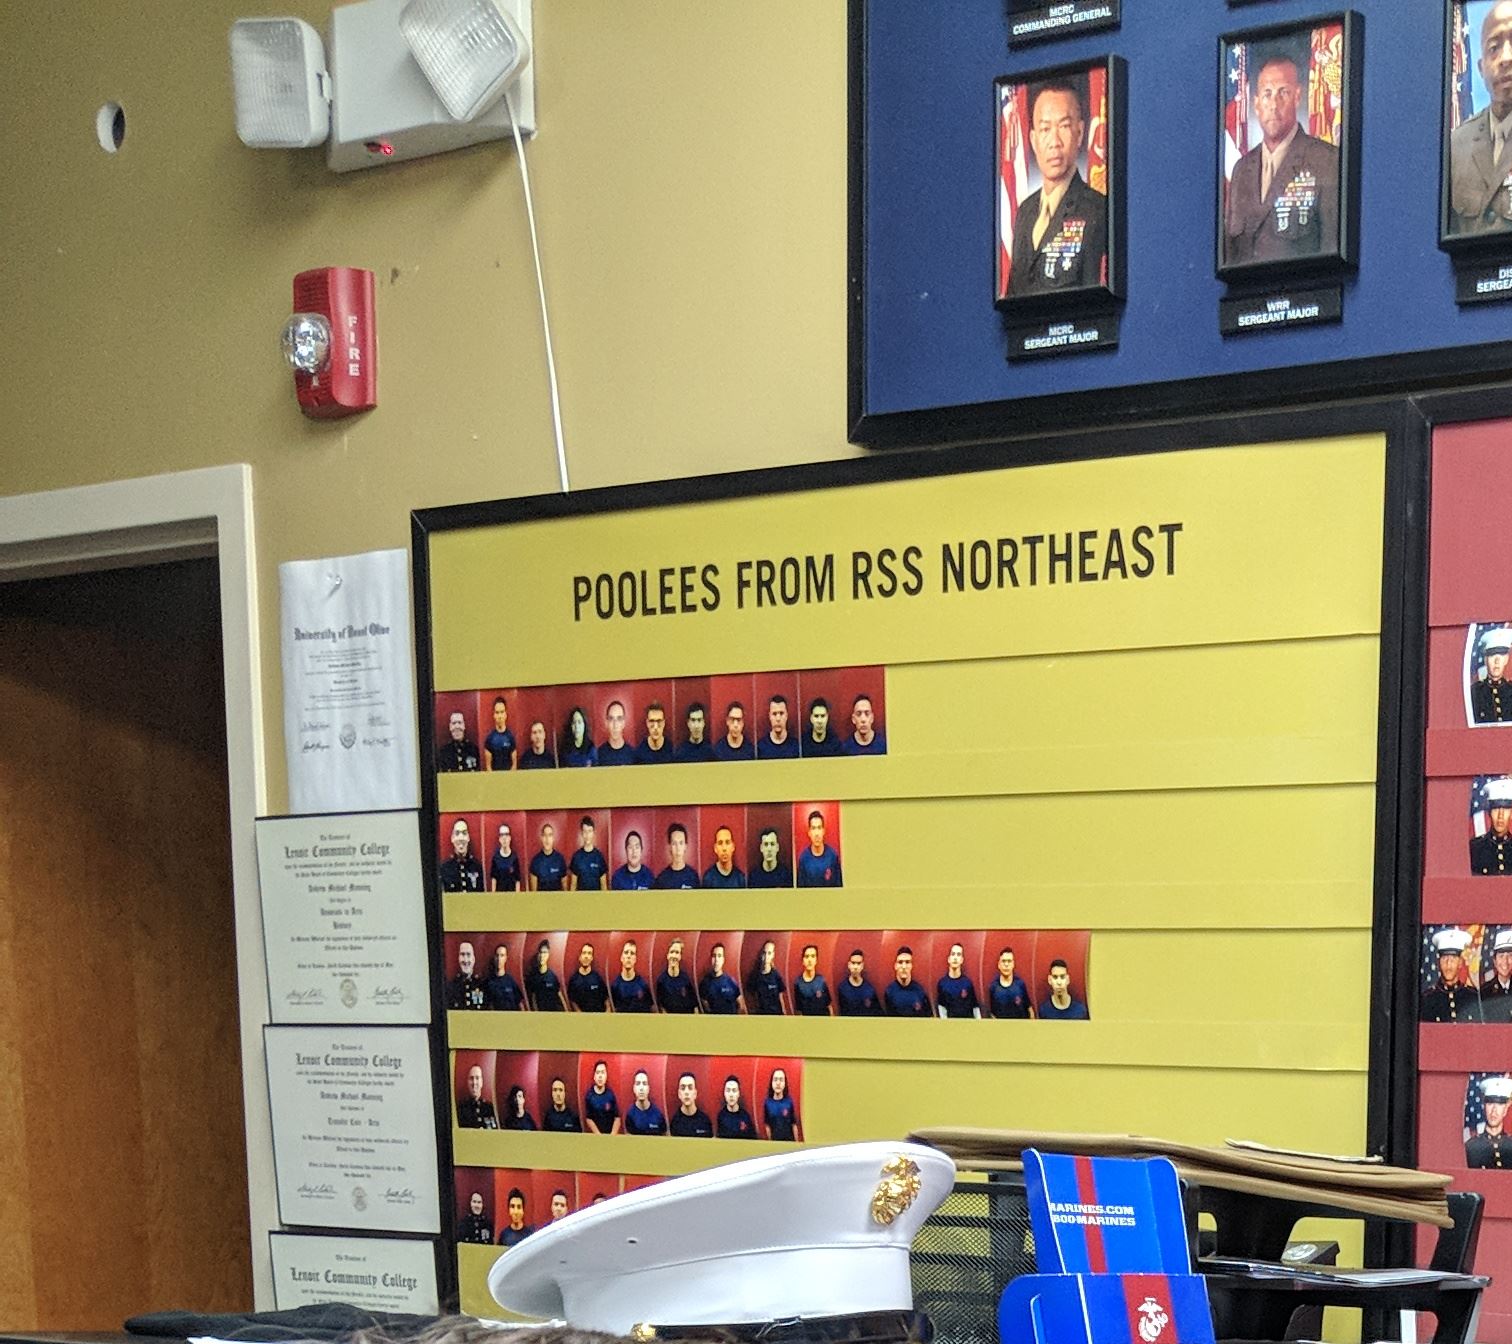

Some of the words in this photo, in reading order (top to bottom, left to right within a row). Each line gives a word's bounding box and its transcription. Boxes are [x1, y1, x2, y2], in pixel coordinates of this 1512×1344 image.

[1013, 14, 1072, 35] COMMANDING
[1073, 7, 1112, 25] GENERAL
[1238, 310, 1286, 327] SERGEANT
[1287, 305, 1319, 320] MAJOR
[1266, 299, 1290, 312] WRR
[1024, 333, 1070, 351] SERGEANT
[1069, 330, 1099, 345] MAJOR
[1048, 323, 1075, 337] MCRC
[348, 315, 361, 377] FIRE
[572, 562, 722, 622] POOLEES
[736, 553, 836, 610] FROM
[850, 545, 924, 601] RSS
[940, 521, 1185, 594] NORTHEAST
[312, 845, 357, 858] Community
[360, 842, 391, 858] College
[324, 1053, 369, 1067] Community
[372, 1054, 402, 1070] College
[290, 1266, 321, 1282] Lenoir
[323, 1269, 378, 1289] Community
[382, 1272, 418, 1292] College
